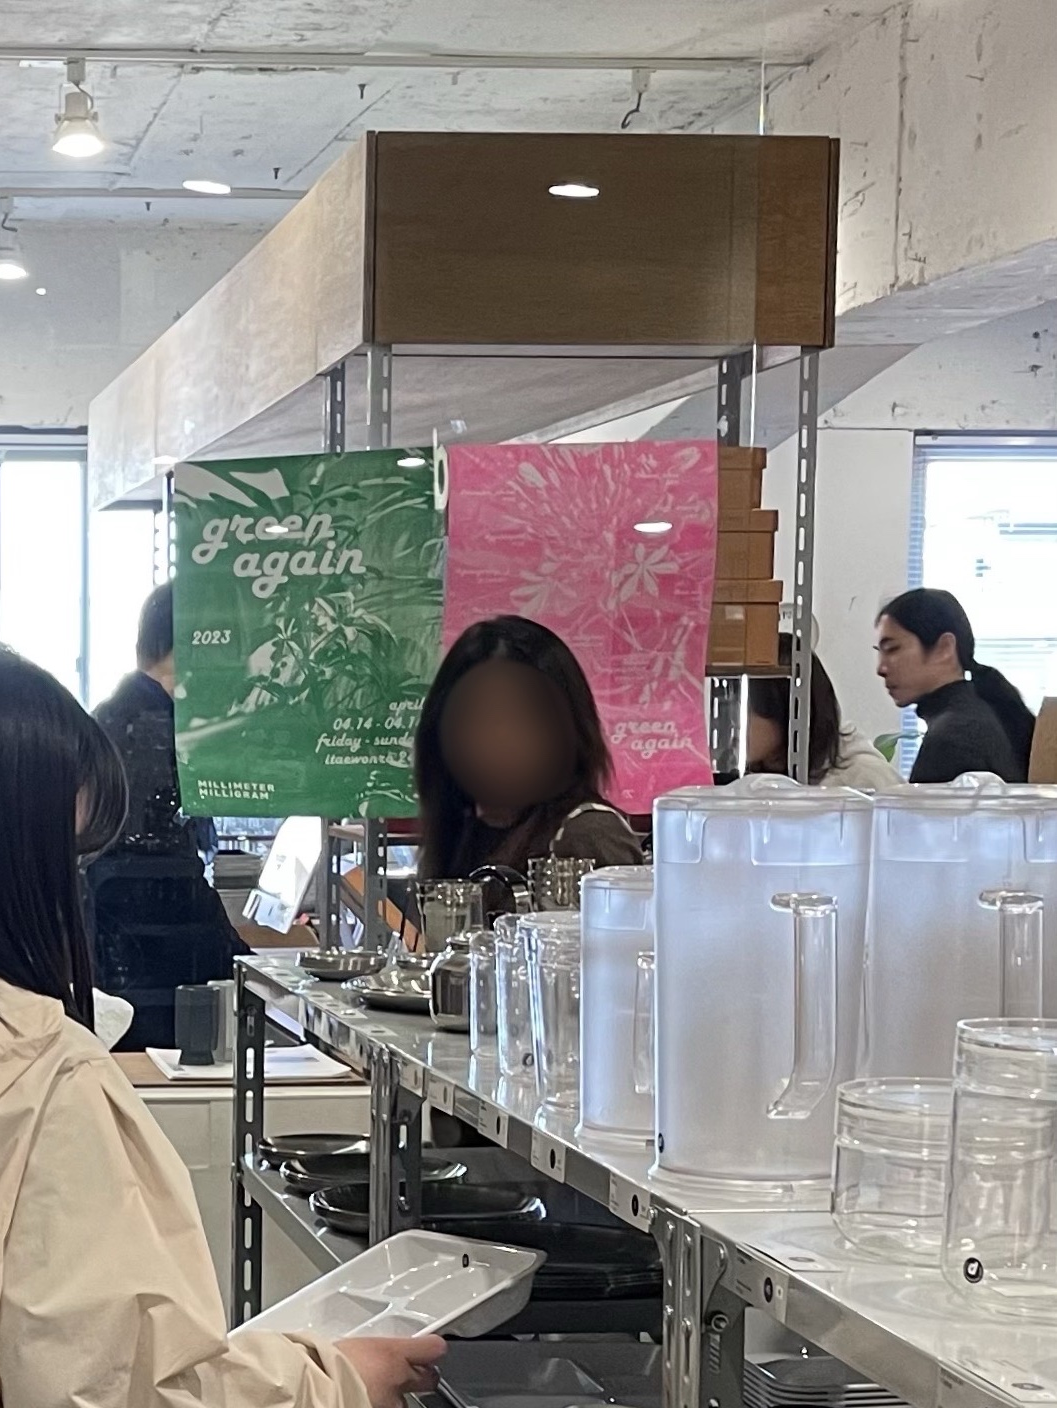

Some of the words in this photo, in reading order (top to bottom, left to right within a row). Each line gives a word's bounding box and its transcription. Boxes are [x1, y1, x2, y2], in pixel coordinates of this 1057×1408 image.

[192, 514, 336, 564] green
[233, 540, 367, 598] again
[192, 630, 231, 645] 2023
[389, 697, 426, 717] april
[333, 717, 373, 731] 04.14
[384, 716, 420, 730] 04.1
[611, 721, 677, 744] green
[315, 732, 361, 753] friday
[630, 730, 692, 760] again
[197, 780, 275, 793] MILLIMETER
[199, 788, 269, 800] MILLIGRAM
